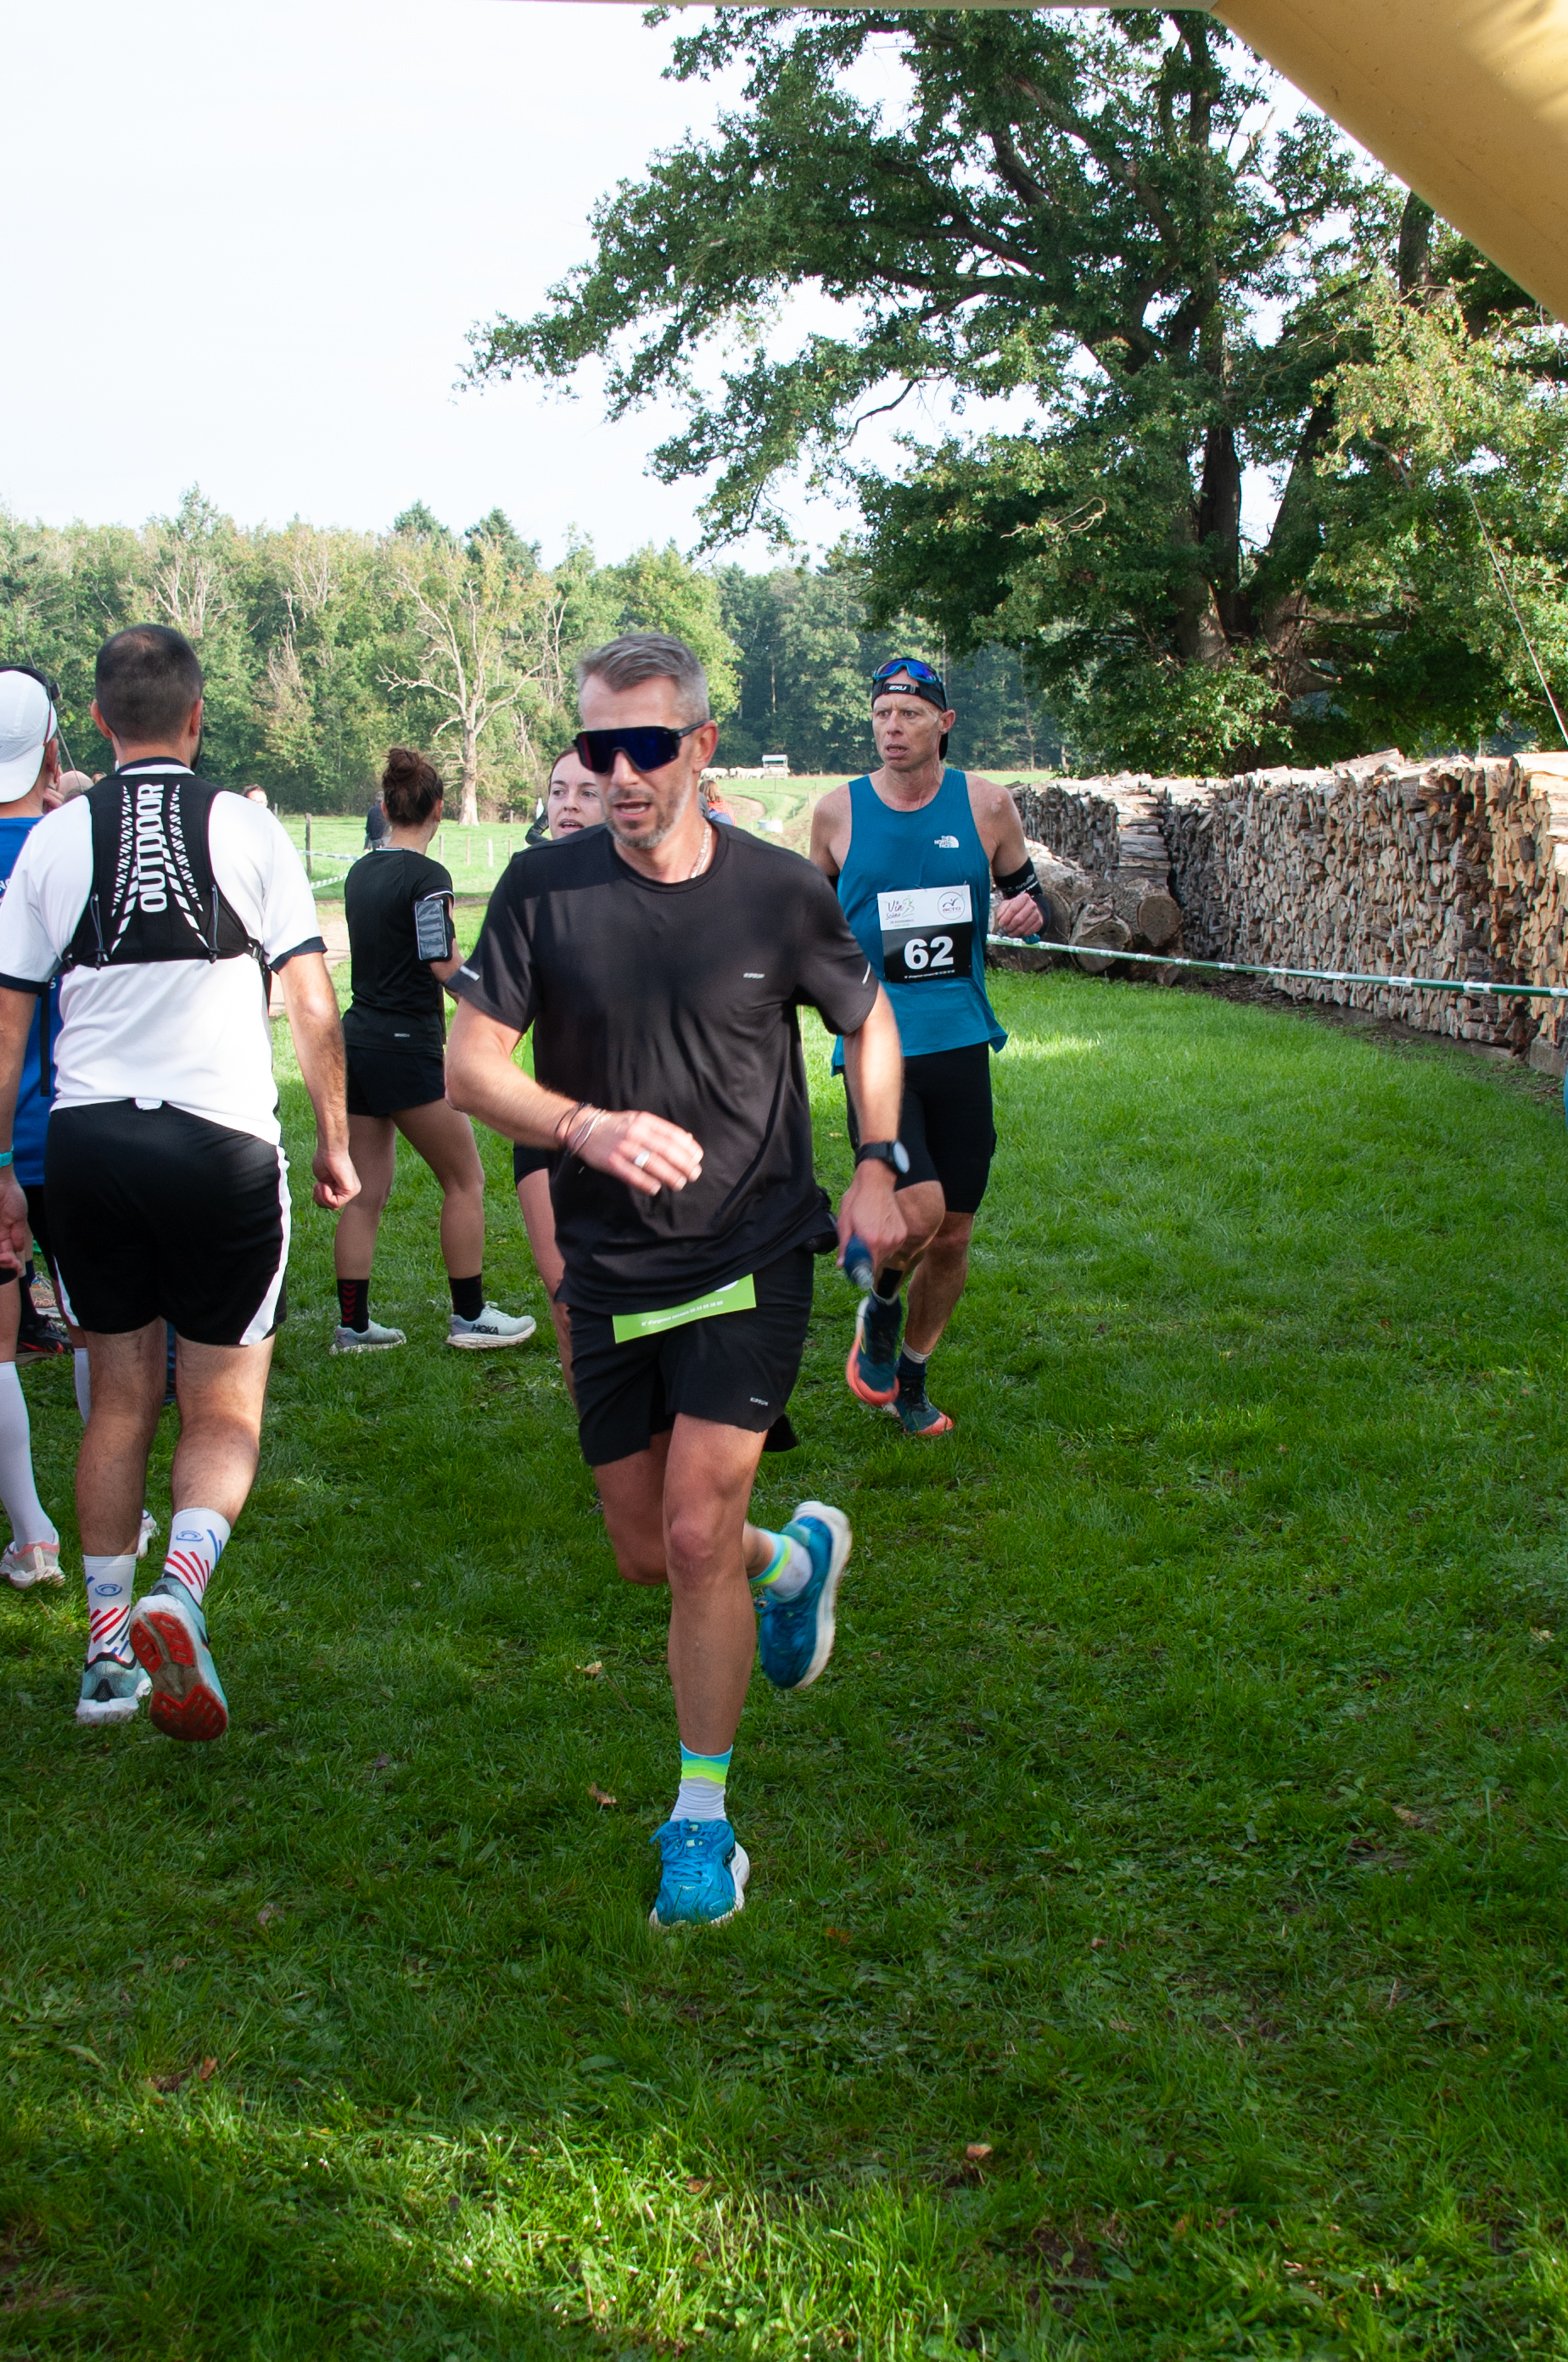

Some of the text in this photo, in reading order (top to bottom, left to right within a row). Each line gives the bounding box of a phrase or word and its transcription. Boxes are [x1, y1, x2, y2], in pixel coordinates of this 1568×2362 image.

[136, 784, 167, 913] OUTDOOR
[904, 936, 954, 970] 62
[471, 1324, 499, 1335] HOKA
